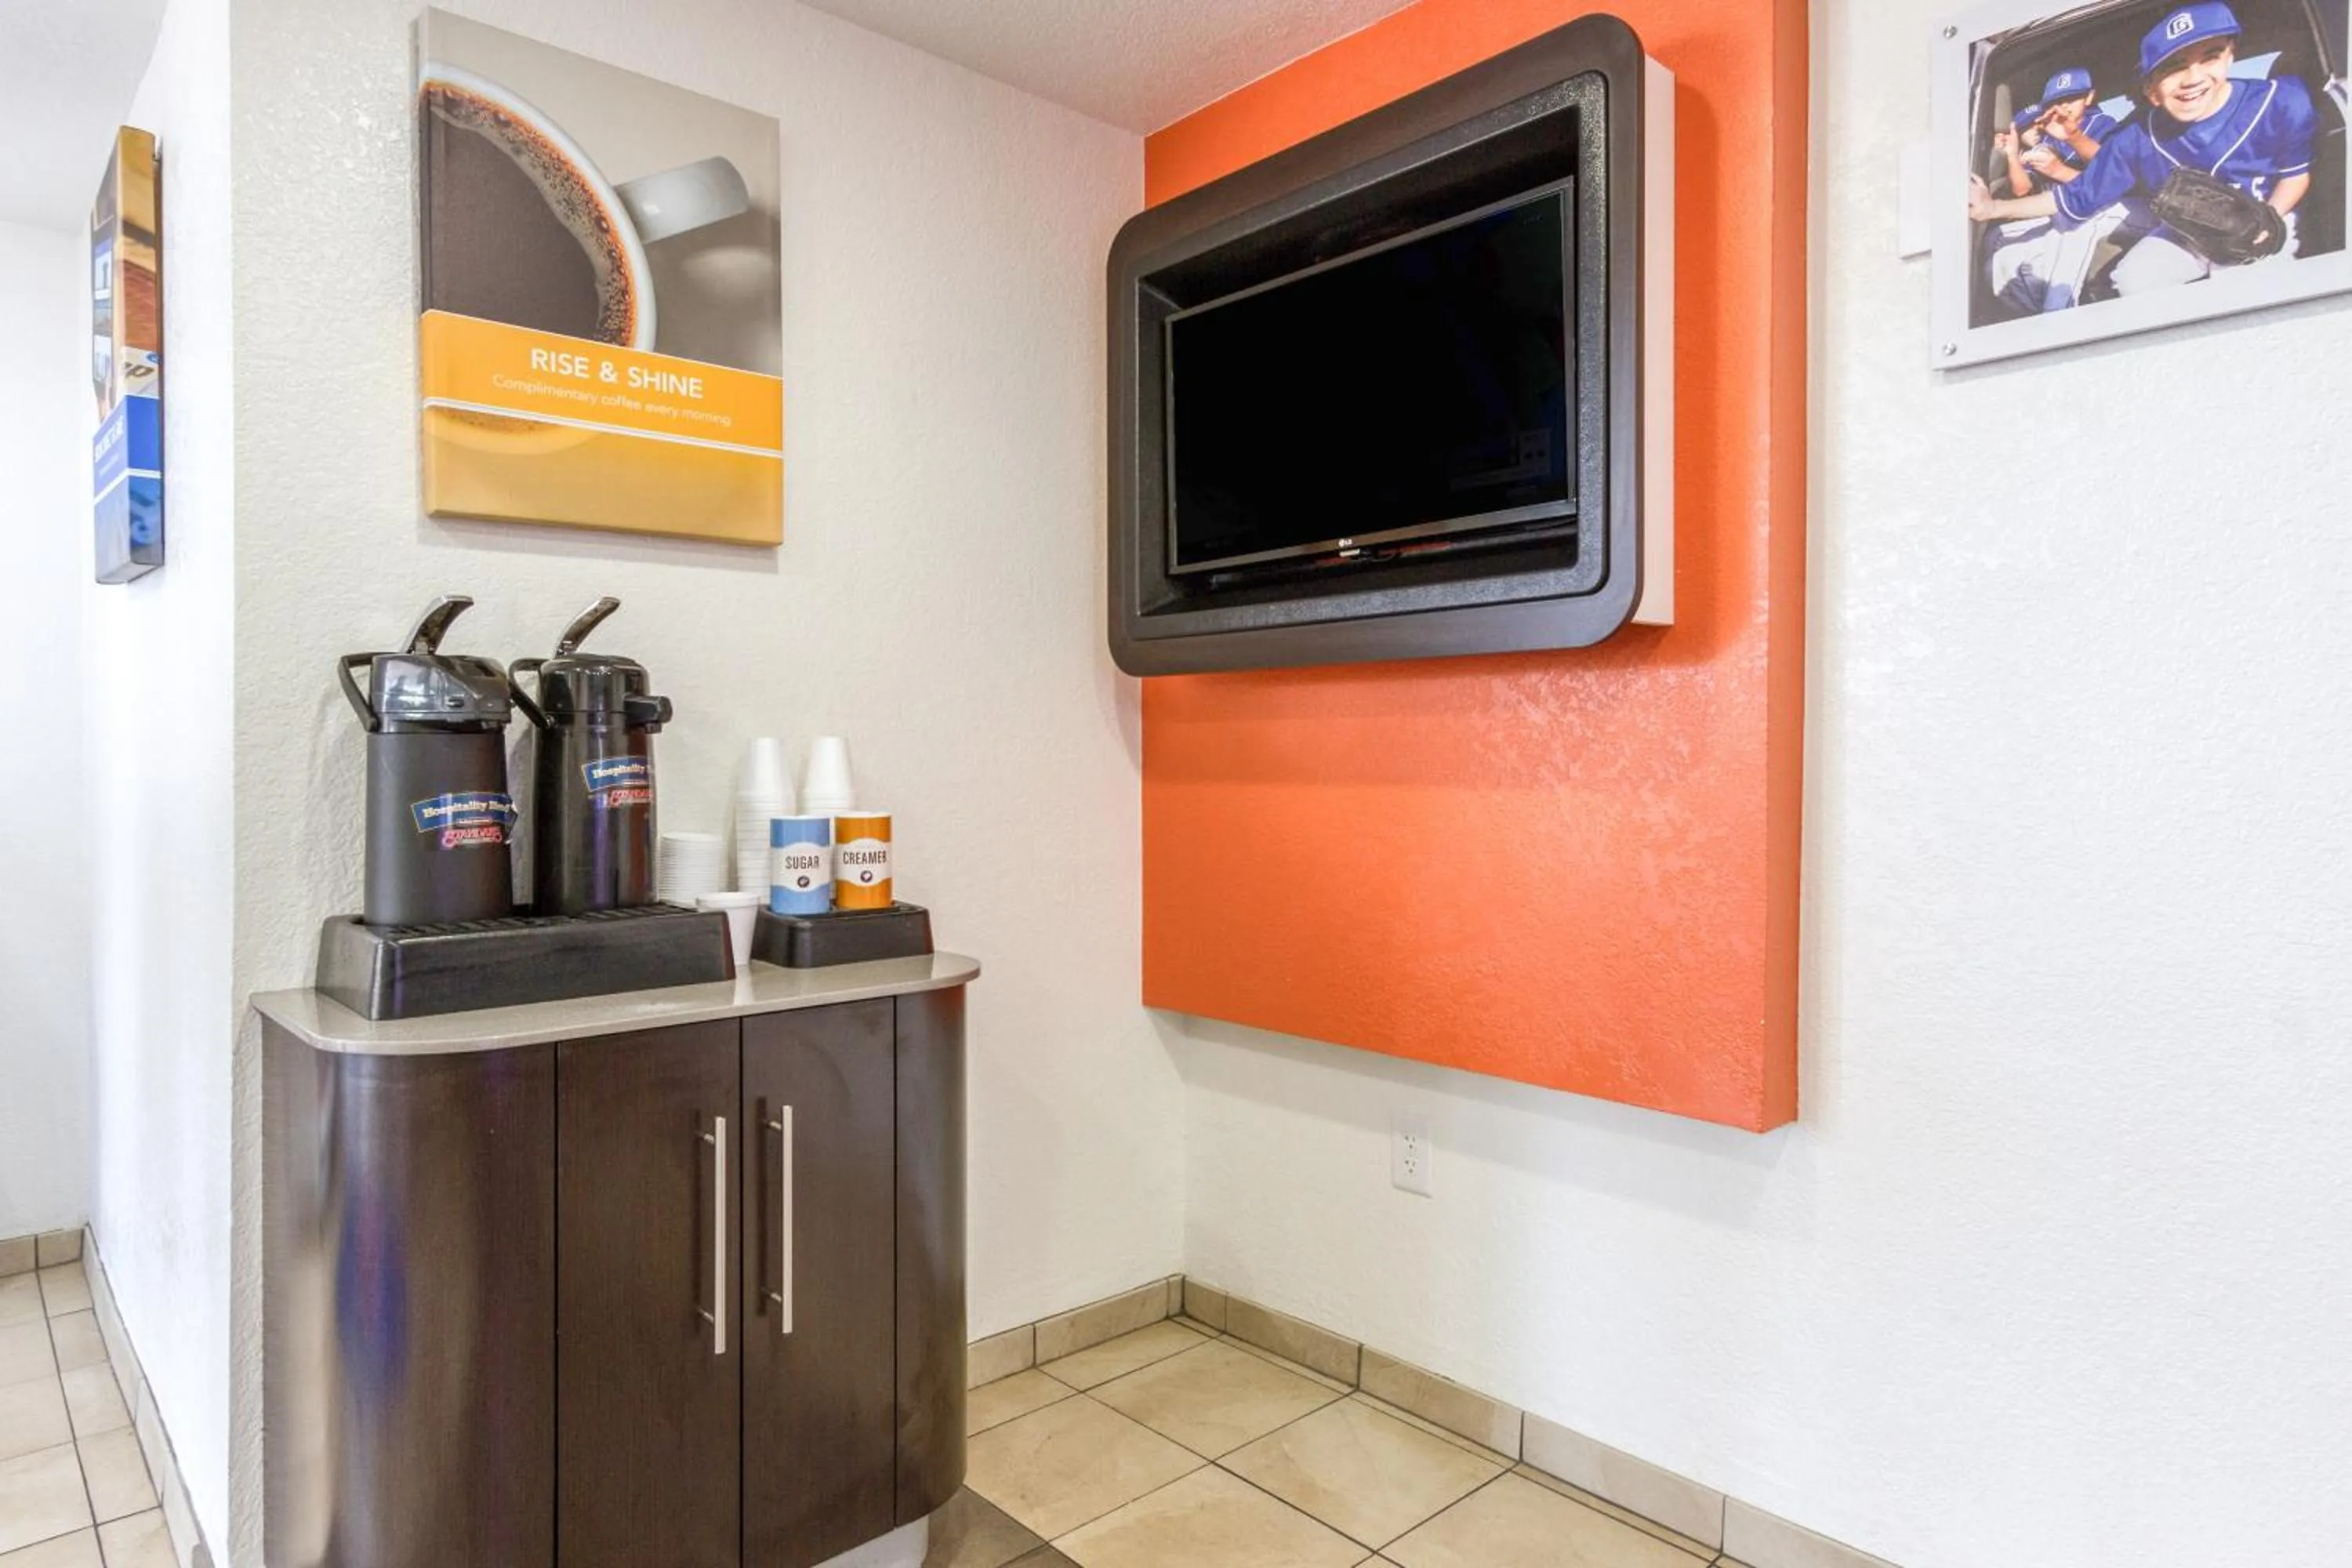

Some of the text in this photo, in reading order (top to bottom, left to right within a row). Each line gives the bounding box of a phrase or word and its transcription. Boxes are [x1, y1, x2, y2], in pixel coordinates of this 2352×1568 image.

[531, 347, 703, 399] RISE & SHINE
[492, 373, 731, 426] Complimentary coffee every morning
[785, 855, 820, 869] SUGAR
